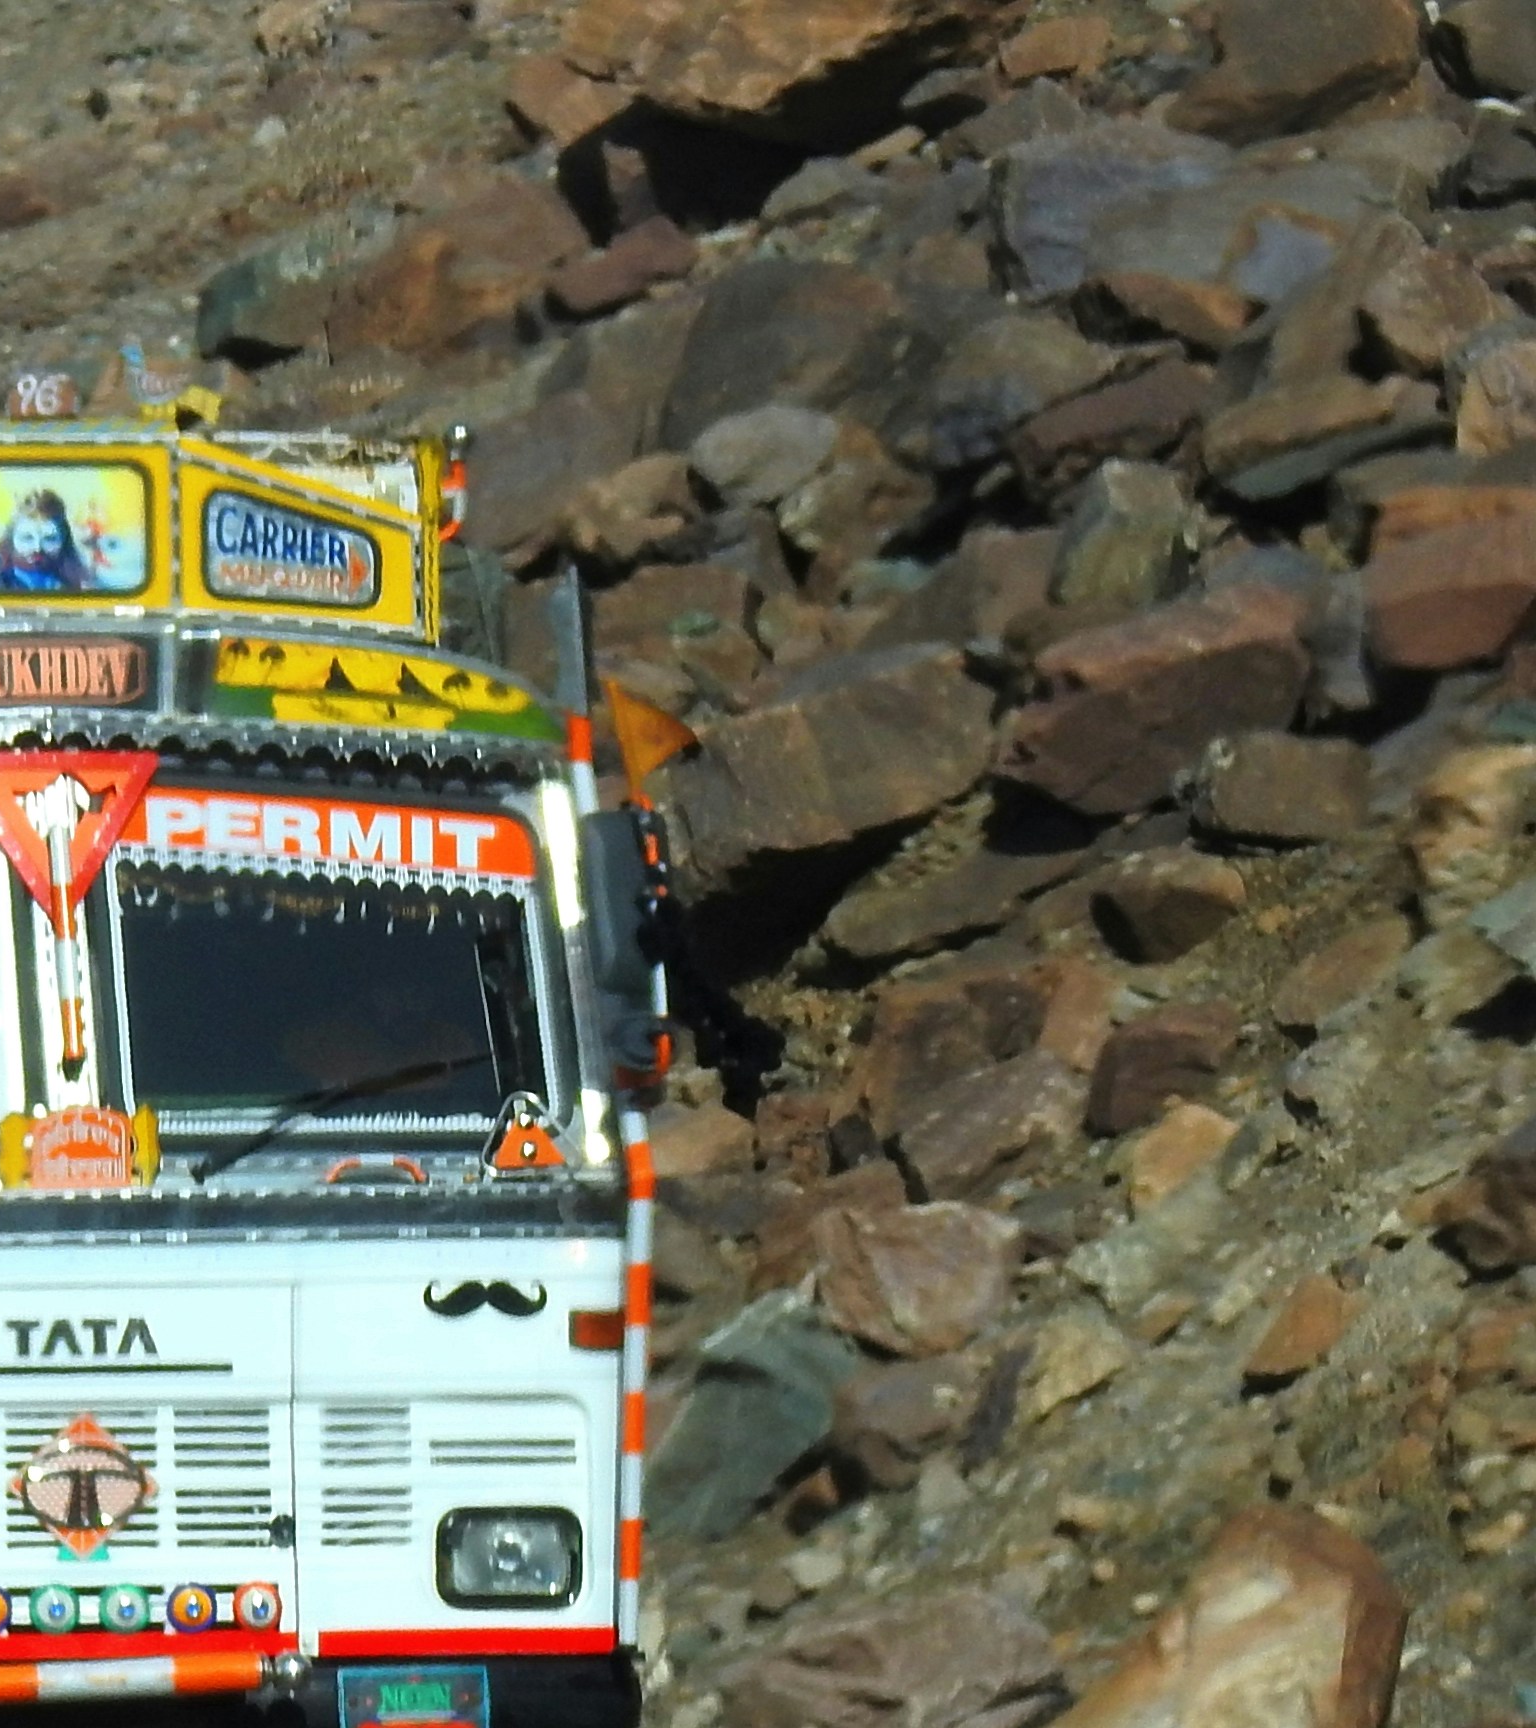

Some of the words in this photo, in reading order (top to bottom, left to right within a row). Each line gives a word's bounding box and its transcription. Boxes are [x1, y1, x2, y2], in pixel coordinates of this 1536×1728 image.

[215, 505, 350, 571] CARRIER
[145, 797, 496, 869] PERMIT
[5, 1318, 159, 1355] TATA
